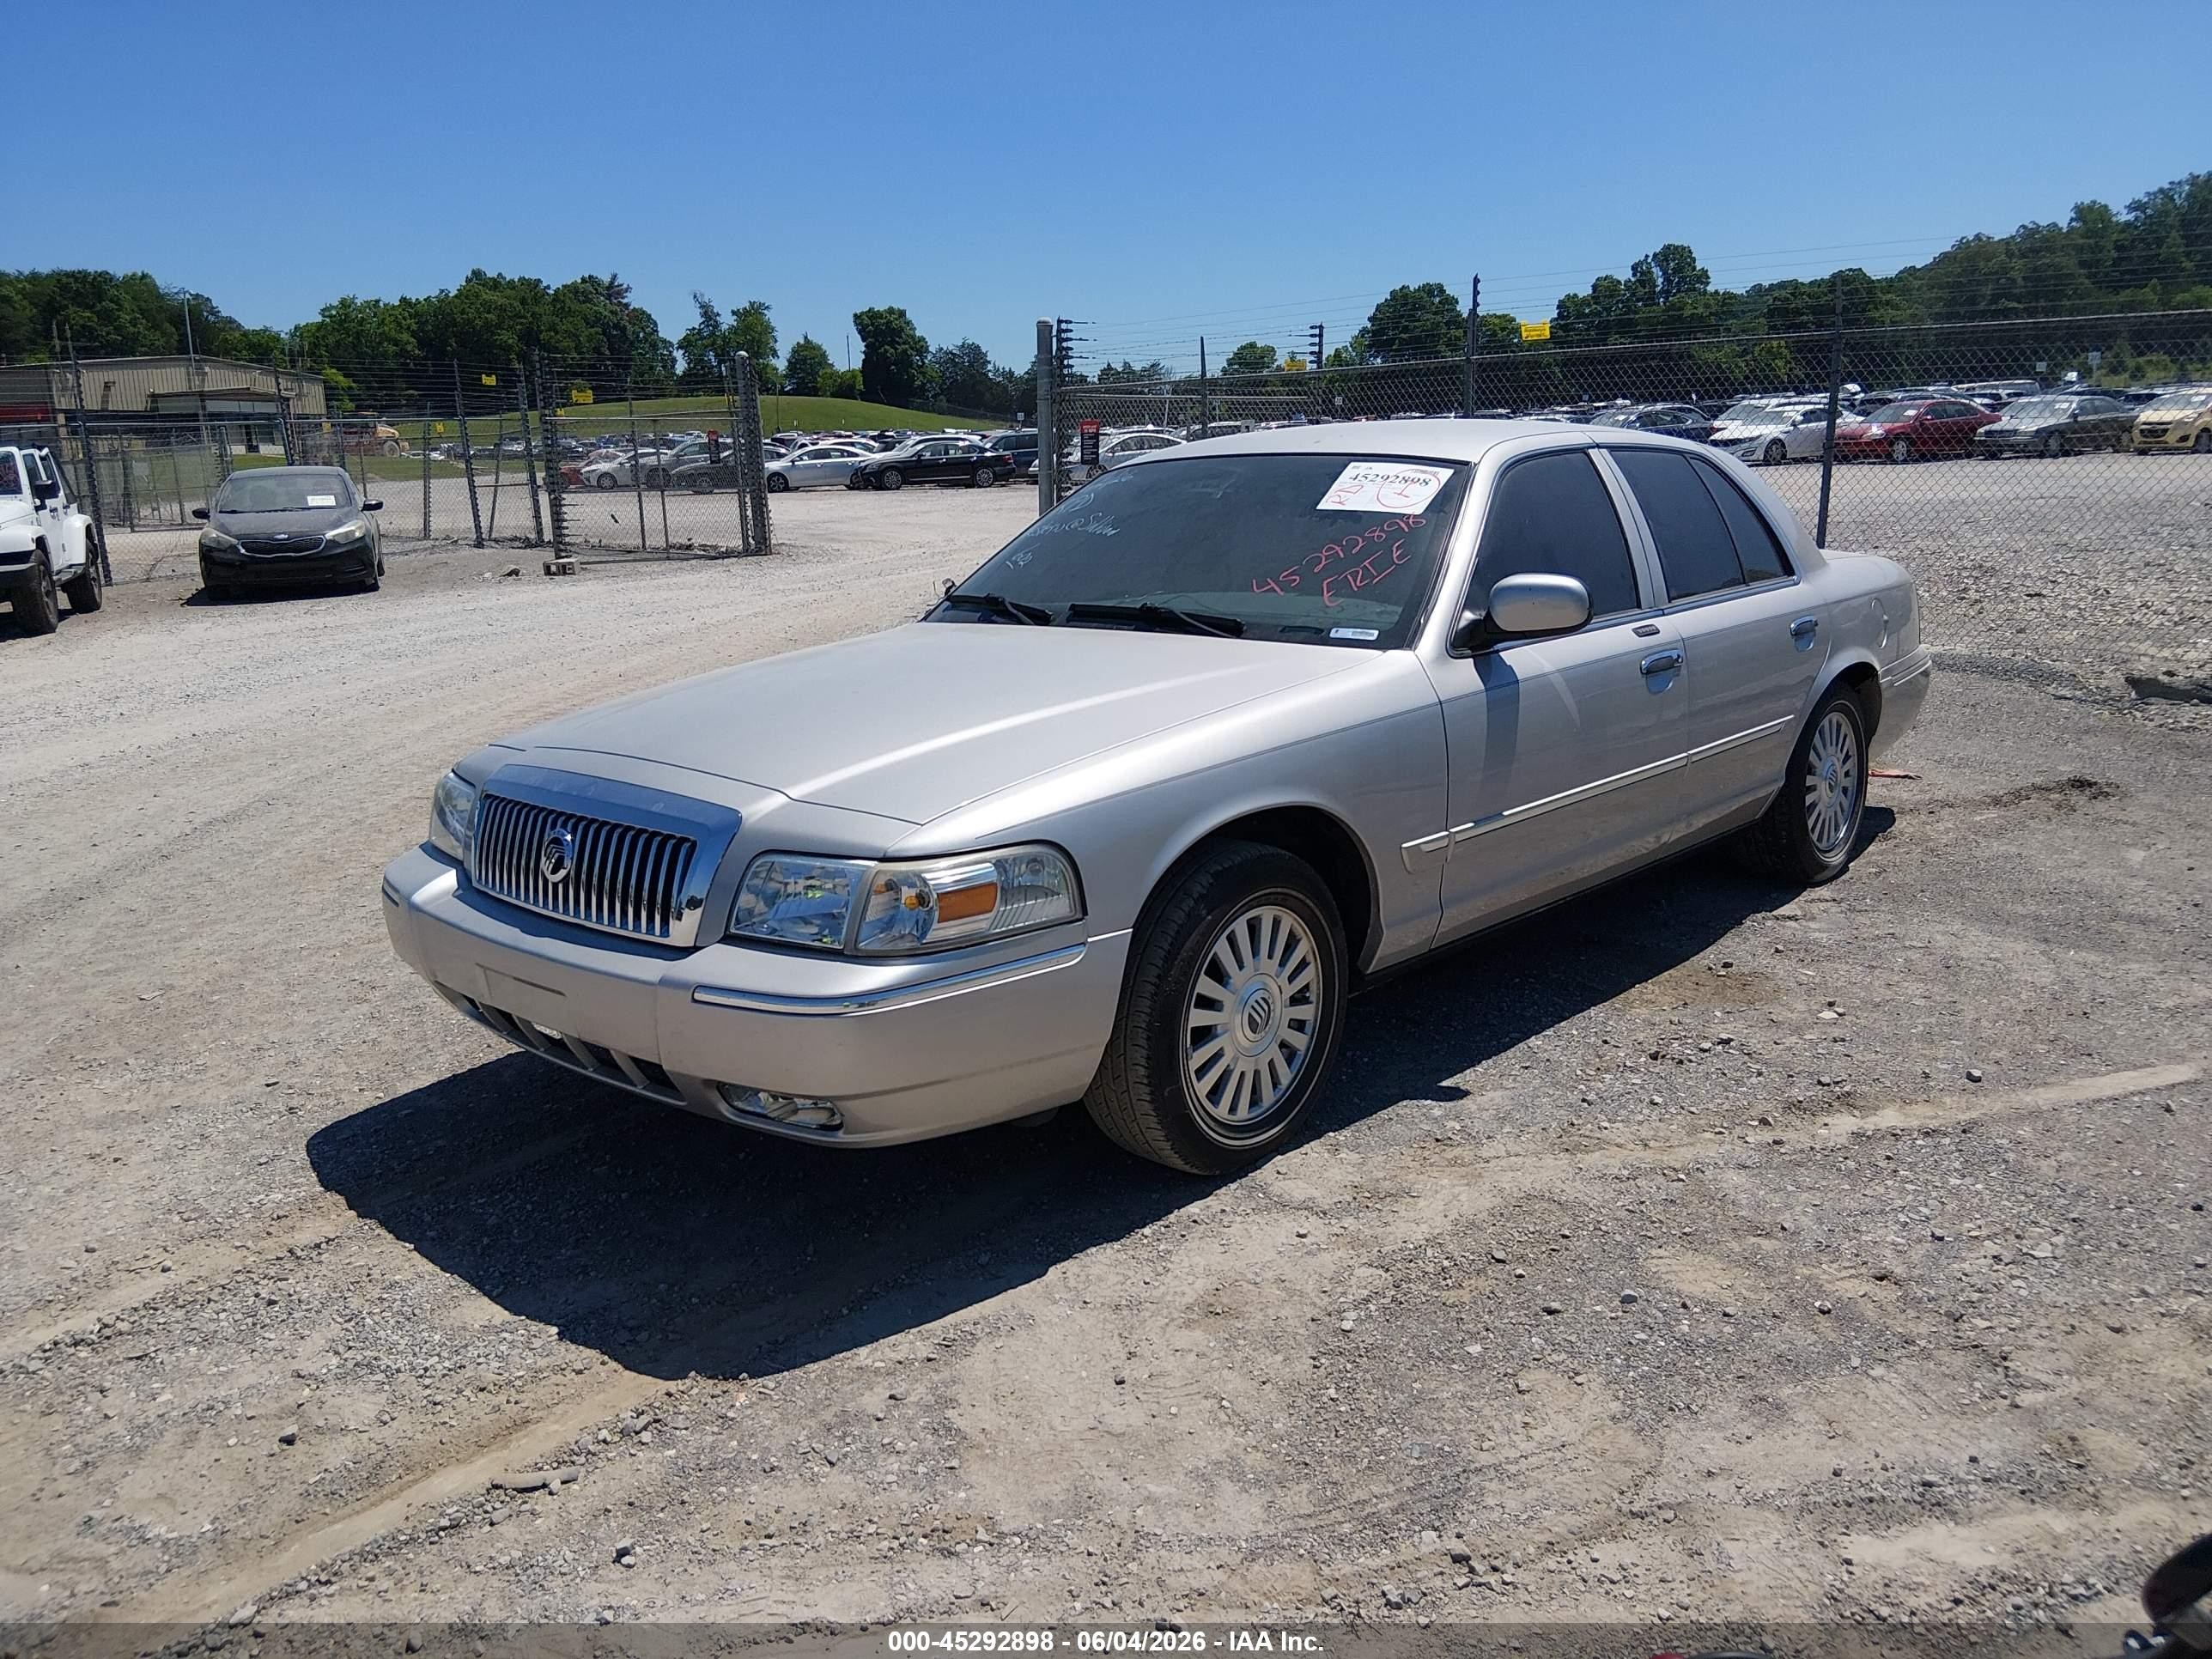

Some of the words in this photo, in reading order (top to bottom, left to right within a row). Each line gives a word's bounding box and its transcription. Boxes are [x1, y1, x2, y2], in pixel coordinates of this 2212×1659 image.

[1348, 472, 1432, 487] 45292898
[1252, 512, 1426, 596] 45292898
[1322, 538, 1412, 607] ERIE
